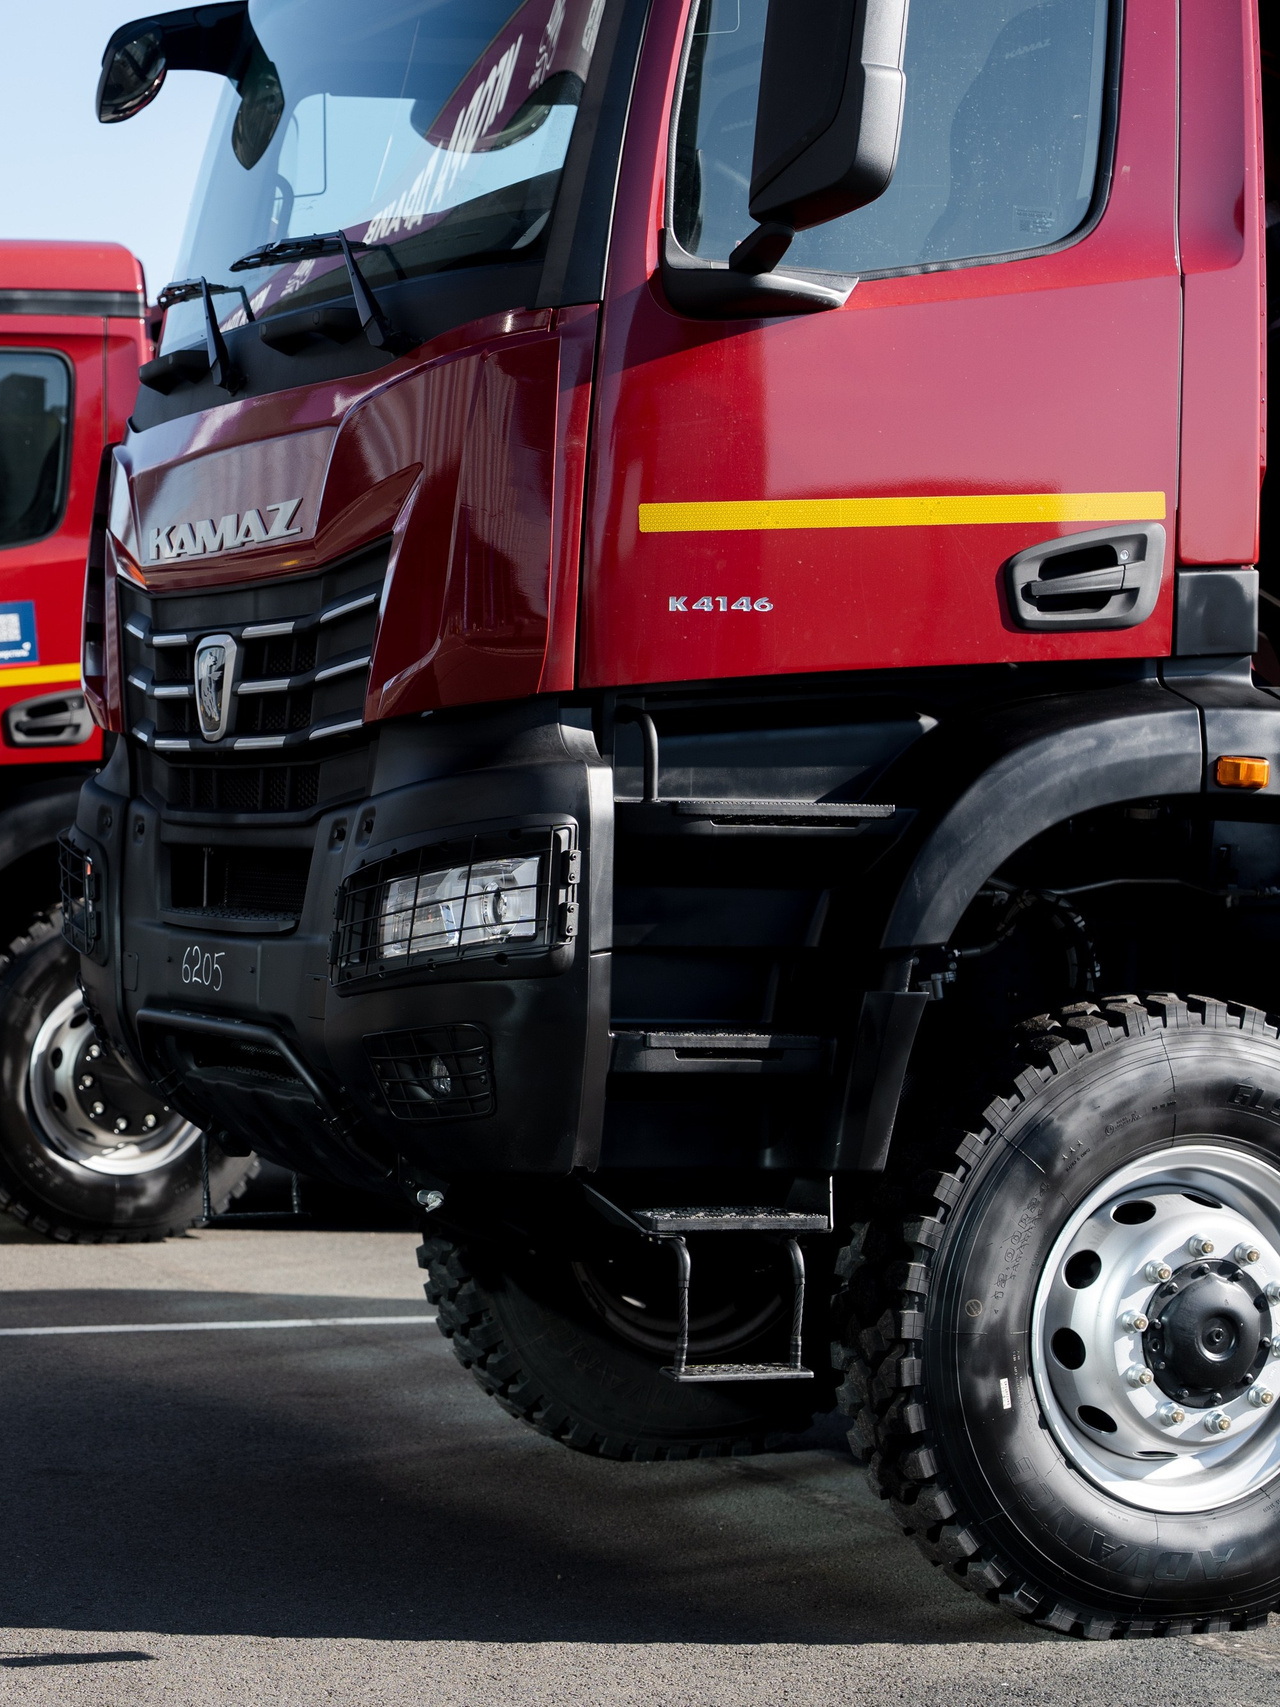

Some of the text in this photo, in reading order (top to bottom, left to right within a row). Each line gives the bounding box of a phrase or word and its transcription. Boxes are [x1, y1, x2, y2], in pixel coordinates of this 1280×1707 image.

[149, 498, 303, 560] KAMAZ
[669, 596, 774, 611] K 4146
[182, 945, 226, 991] 6205
[1004, 1455, 1237, 1583] ADVANCE
